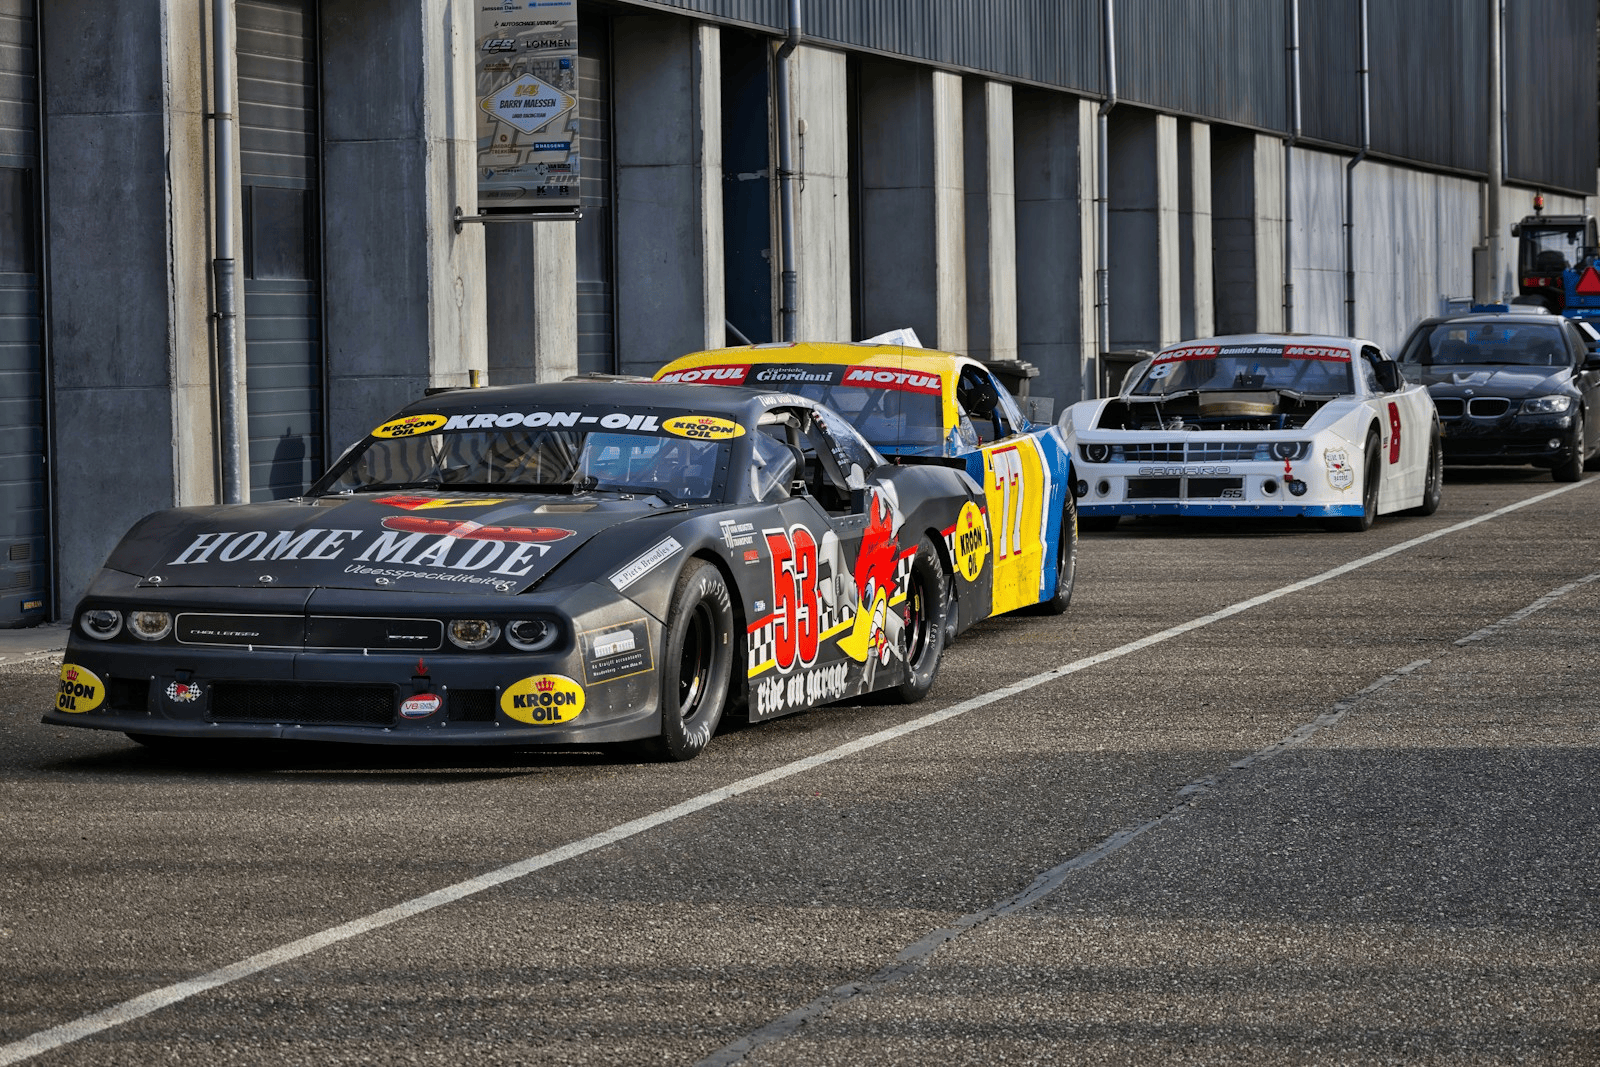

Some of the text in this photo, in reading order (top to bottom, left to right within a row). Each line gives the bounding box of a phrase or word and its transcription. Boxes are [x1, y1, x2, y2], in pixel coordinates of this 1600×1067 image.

[526, 40, 570, 48] LOMMEN
[513, 84, 539, 97] 14
[499, 98, 556, 109] BARRY MAESSEN
[1154, 346, 1350, 361] MOTUL Jennifer Maas MOTUL
[658, 368, 745, 384] MOTUL
[756, 370, 833, 382] Giordani
[1149, 362, 1173, 379] 8
[846, 369, 942, 389] MOTUL
[381, 419, 437, 433] KROON
[443, 411, 660, 432] KROON-OIL
[672, 421, 734, 434] KROON
[391, 428, 417, 437] OIL
[686, 429, 713, 438] OIL
[1388, 401, 1401, 465] 8
[1138, 465, 1231, 476] CAMARO
[1220, 488, 1243, 499] SS
[989, 444, 1025, 560] 77
[960, 525, 982, 557] KROON
[166, 528, 552, 577] HOME MADE
[640, 547, 670, 568] Broodjes
[968, 552, 978, 577] OIL
[763, 524, 820, 675] 53
[190, 629, 260, 637] CHALLENGER
[60, 680, 96, 700] ROON
[806, 661, 849, 706] garage
[60, 694, 77, 711] OIL
[405, 702, 419, 711] V8
[512, 691, 572, 709] KROON
[532, 706, 563, 722] OIL
